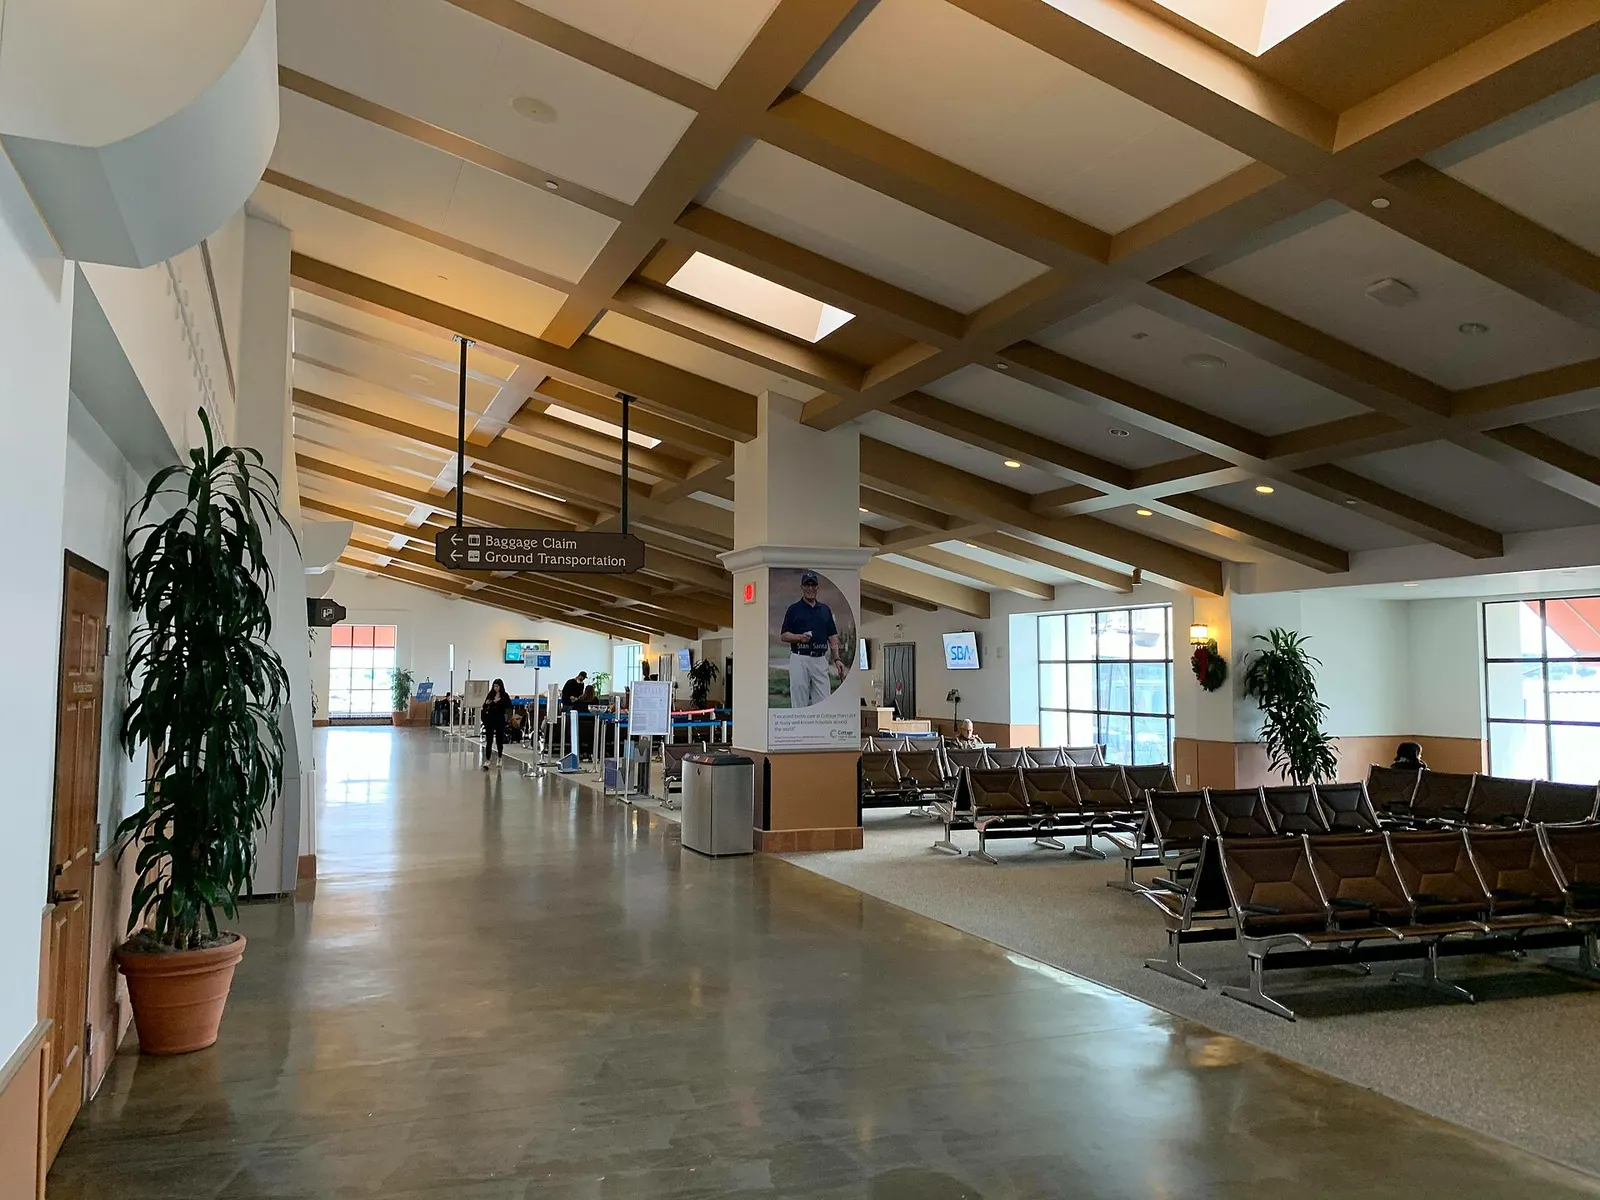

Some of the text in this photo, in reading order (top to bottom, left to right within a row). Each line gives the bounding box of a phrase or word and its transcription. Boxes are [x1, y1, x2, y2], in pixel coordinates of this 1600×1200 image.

[485, 535, 577, 550] Baggage Claim
[485, 551, 626, 568] Ground Transportation
[796, 642, 810, 650] Stan
[812, 642, 828, 650] Santa
